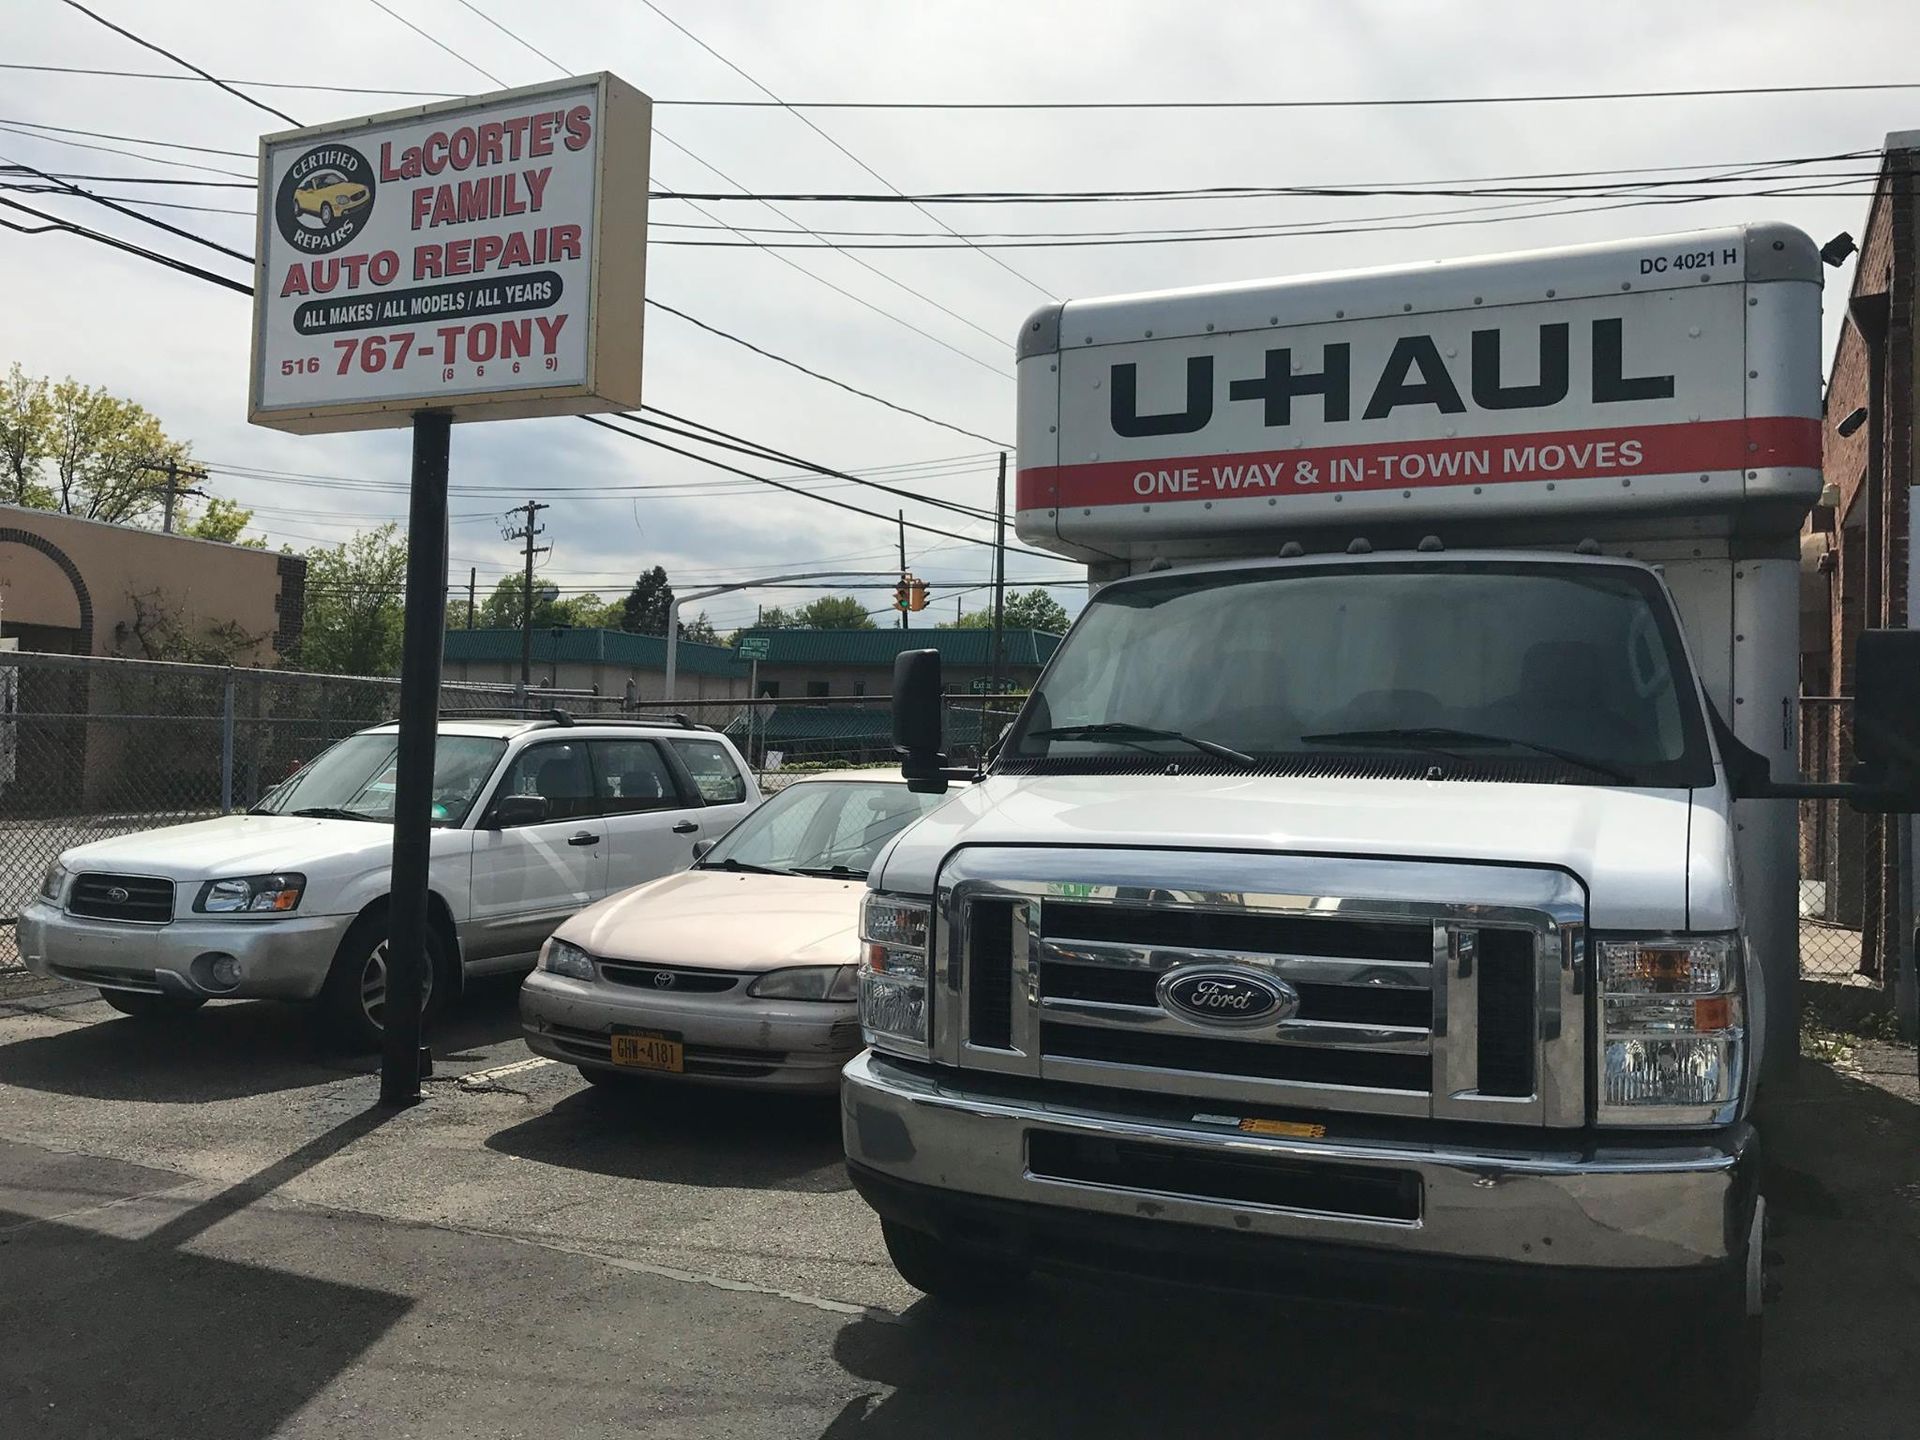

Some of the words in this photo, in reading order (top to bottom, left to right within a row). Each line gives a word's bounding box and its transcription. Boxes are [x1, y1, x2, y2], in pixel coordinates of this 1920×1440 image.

[292, 149, 359, 181] CERTIFIED
[380, 105, 592, 183] LaCORTE'S
[411, 167, 553, 231] FAMILY
[293, 218, 355, 250] REPAIRS
[280, 249, 400, 298] AUTO
[413, 224, 582, 280] REPAIR
[1640, 257, 1668, 275] DC
[1673, 250, 1715, 270] 4021
[1723, 248, 1737, 265] H
[303, 310, 326, 328] ALL
[329, 305, 373, 325] MAKES
[383, 298, 407, 319] ALL
[410, 293, 465, 316] MODELS
[475, 287, 502, 308] ALL
[504, 281, 552, 303] YEARS
[281, 356, 320, 377] 516
[333, 314, 569, 375] 767-TONY
[442, 366, 454, 383] (8
[476, 364, 484, 378] 6
[512, 360, 520, 375] 6
[545, 357, 558, 372] 9)
[1132, 462, 1285, 496] ONE-WAY
[1293, 460, 1320, 486] &
[1328, 450, 1492, 484] IN-TOWN
[1502, 440, 1644, 472] MOVES
[1191, 980, 1251, 1009] Ford
